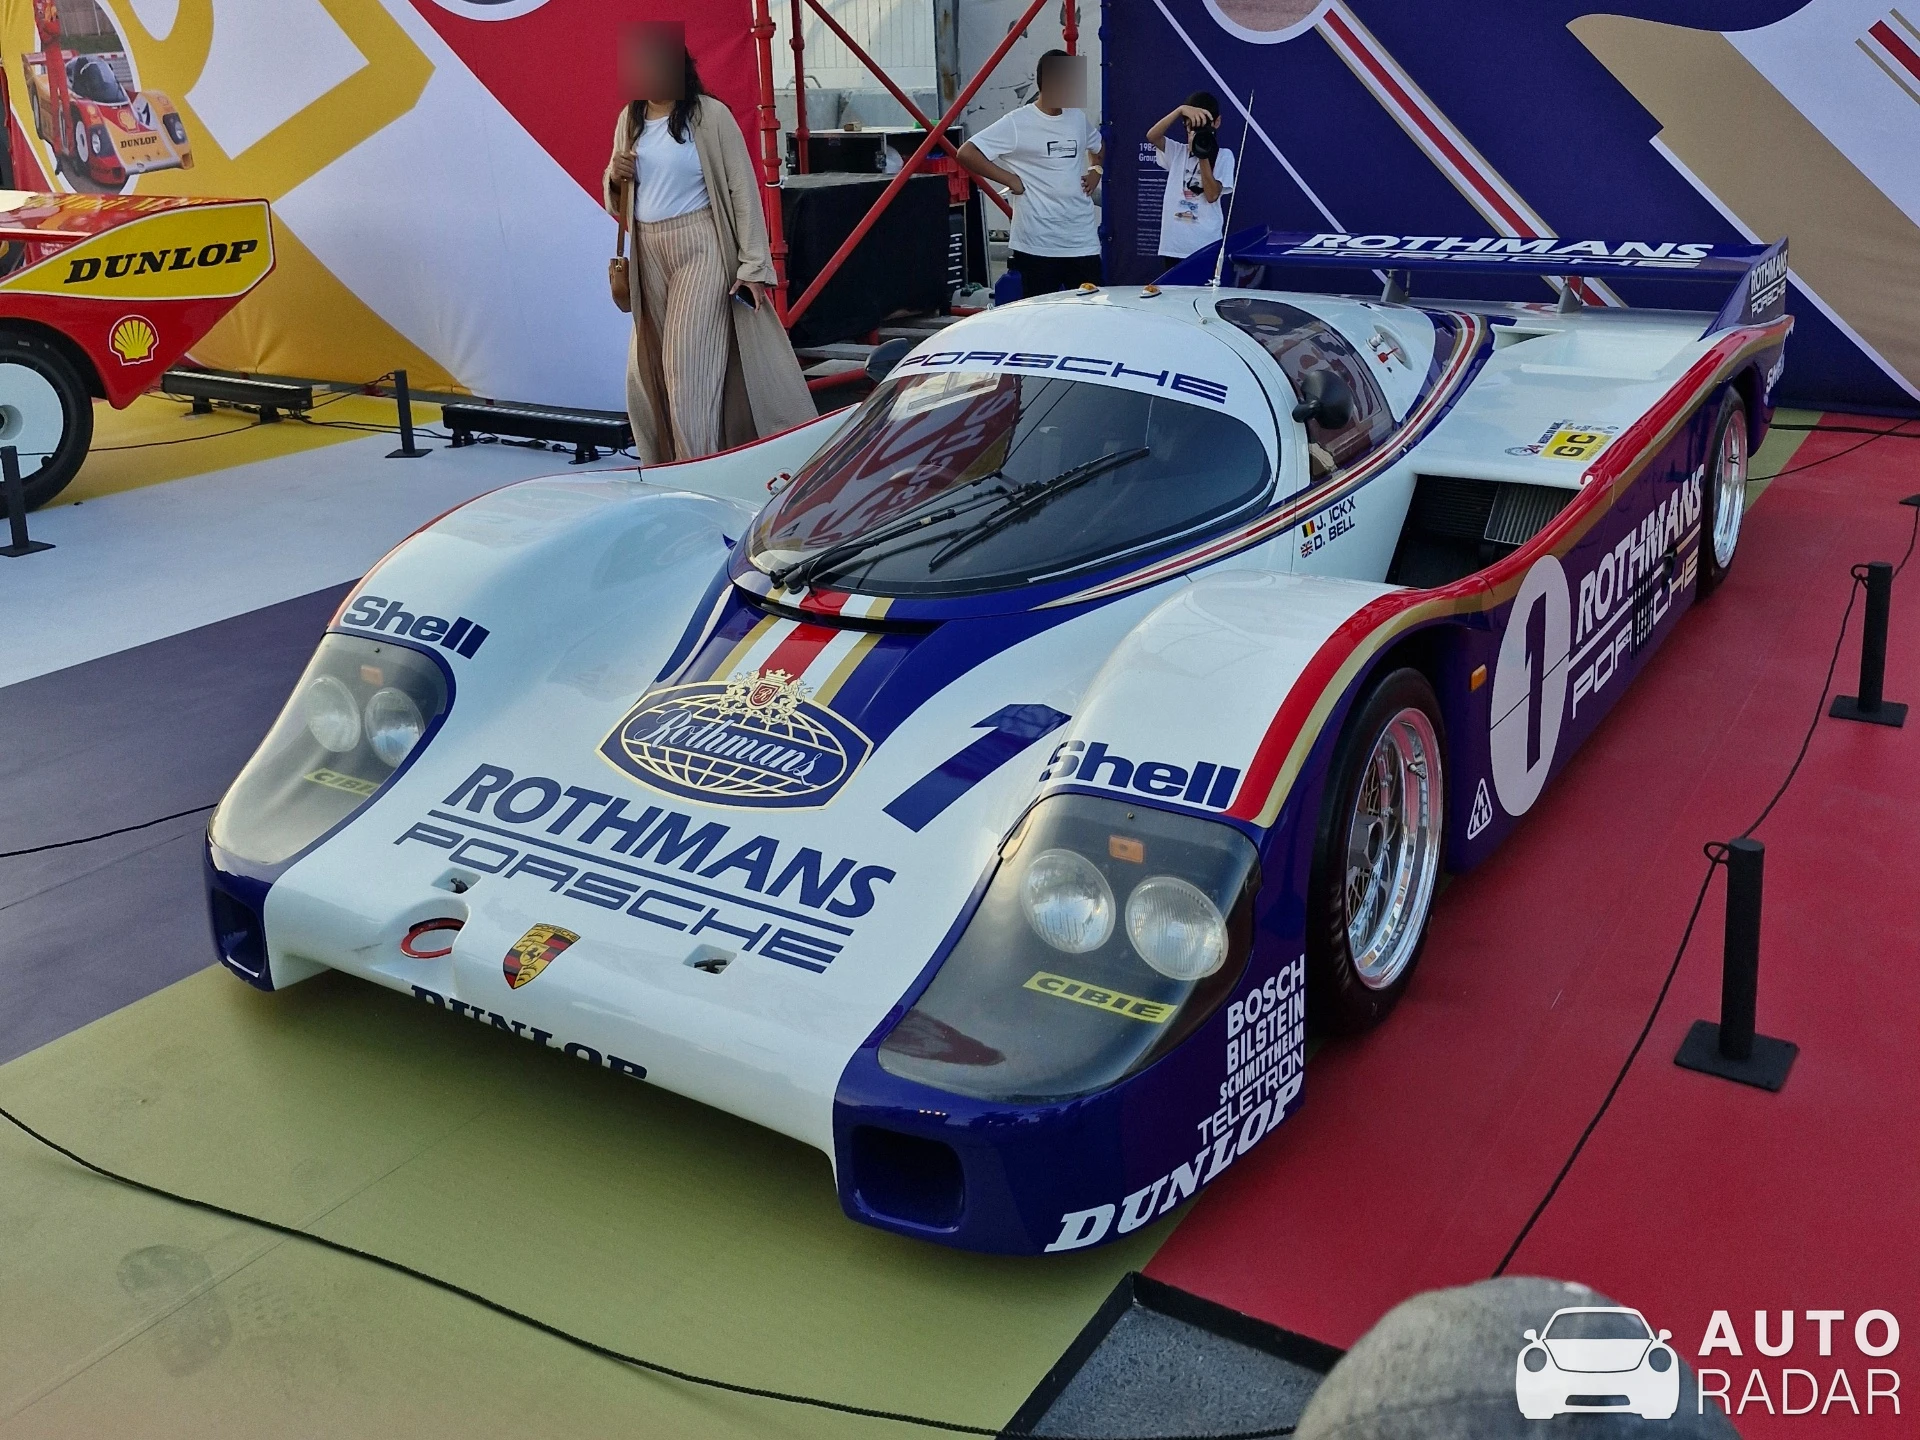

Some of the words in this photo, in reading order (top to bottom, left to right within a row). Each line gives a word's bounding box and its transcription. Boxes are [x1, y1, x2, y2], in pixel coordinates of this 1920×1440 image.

[120, 136, 157, 148] DUNLOP
[64, 239, 258, 284] DUNLOP
[1303, 233, 1713, 259] ROTHMANS
[1751, 249, 1788, 294] ROTHMANS
[1751, 281, 1786, 318] PORSCHE
[893, 351, 1229, 404] PORSCHE
[1314, 534, 1326, 551] D.
[1328, 516, 1355, 541] BELL
[1317, 515, 1326, 531] J.
[1329, 496, 1356, 523] ICKX
[1576, 464, 1704, 644] ROTHMANS
[342, 595, 490, 660] Shell
[1525, 591, 1546, 773] 1
[634, 708, 822, 786] Rothmans
[882, 704, 1072, 833] 1
[1039, 740, 1241, 809] Shell
[314, 772, 377, 794] CIBI
[443, 763, 896, 918] ROTHMANS
[393, 822, 849, 974] PORSCHE
[1037, 978, 1164, 1018] CIBIE
[1228, 954, 1304, 1039] BOSCH
[1220, 1022, 1304, 1105] SCHMITTHELM
[1227, 988, 1304, 1075] BILSTEIN
[1198, 1043, 1304, 1145] TELETRON
[1044, 1071, 1303, 1252] DUNLOP
